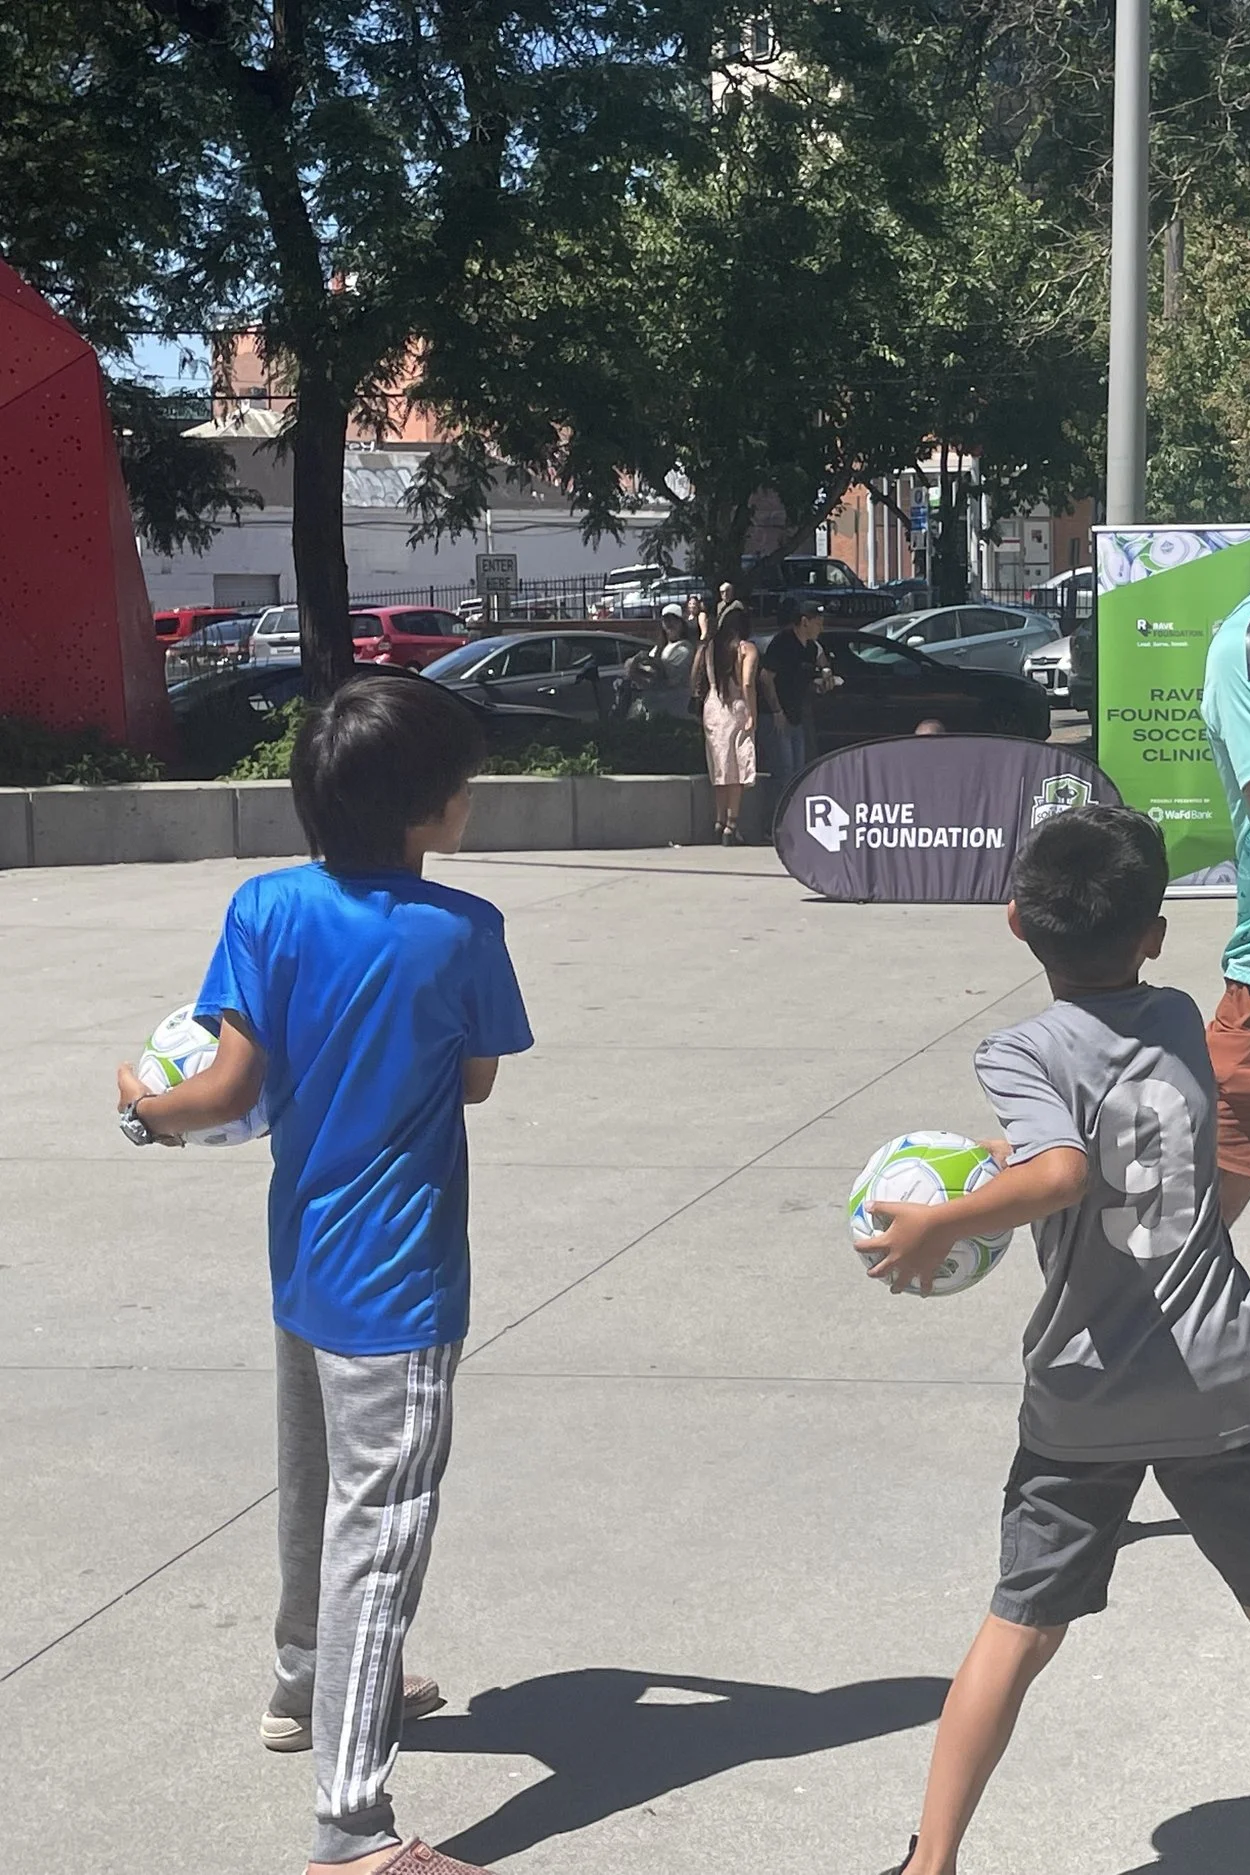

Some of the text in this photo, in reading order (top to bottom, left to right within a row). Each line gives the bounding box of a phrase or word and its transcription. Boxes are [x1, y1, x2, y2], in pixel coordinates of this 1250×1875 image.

[482, 559, 513, 572] ENTER
[1152, 622, 1174, 630] RAVE
[1150, 688, 1205, 702] RAVE
[1107, 708, 1203, 722] FOUNDA
[1132, 728, 1207, 742] SOCCE
[855, 803, 915, 825] RAVE
[855, 826, 1005, 849] FOUNDATION
